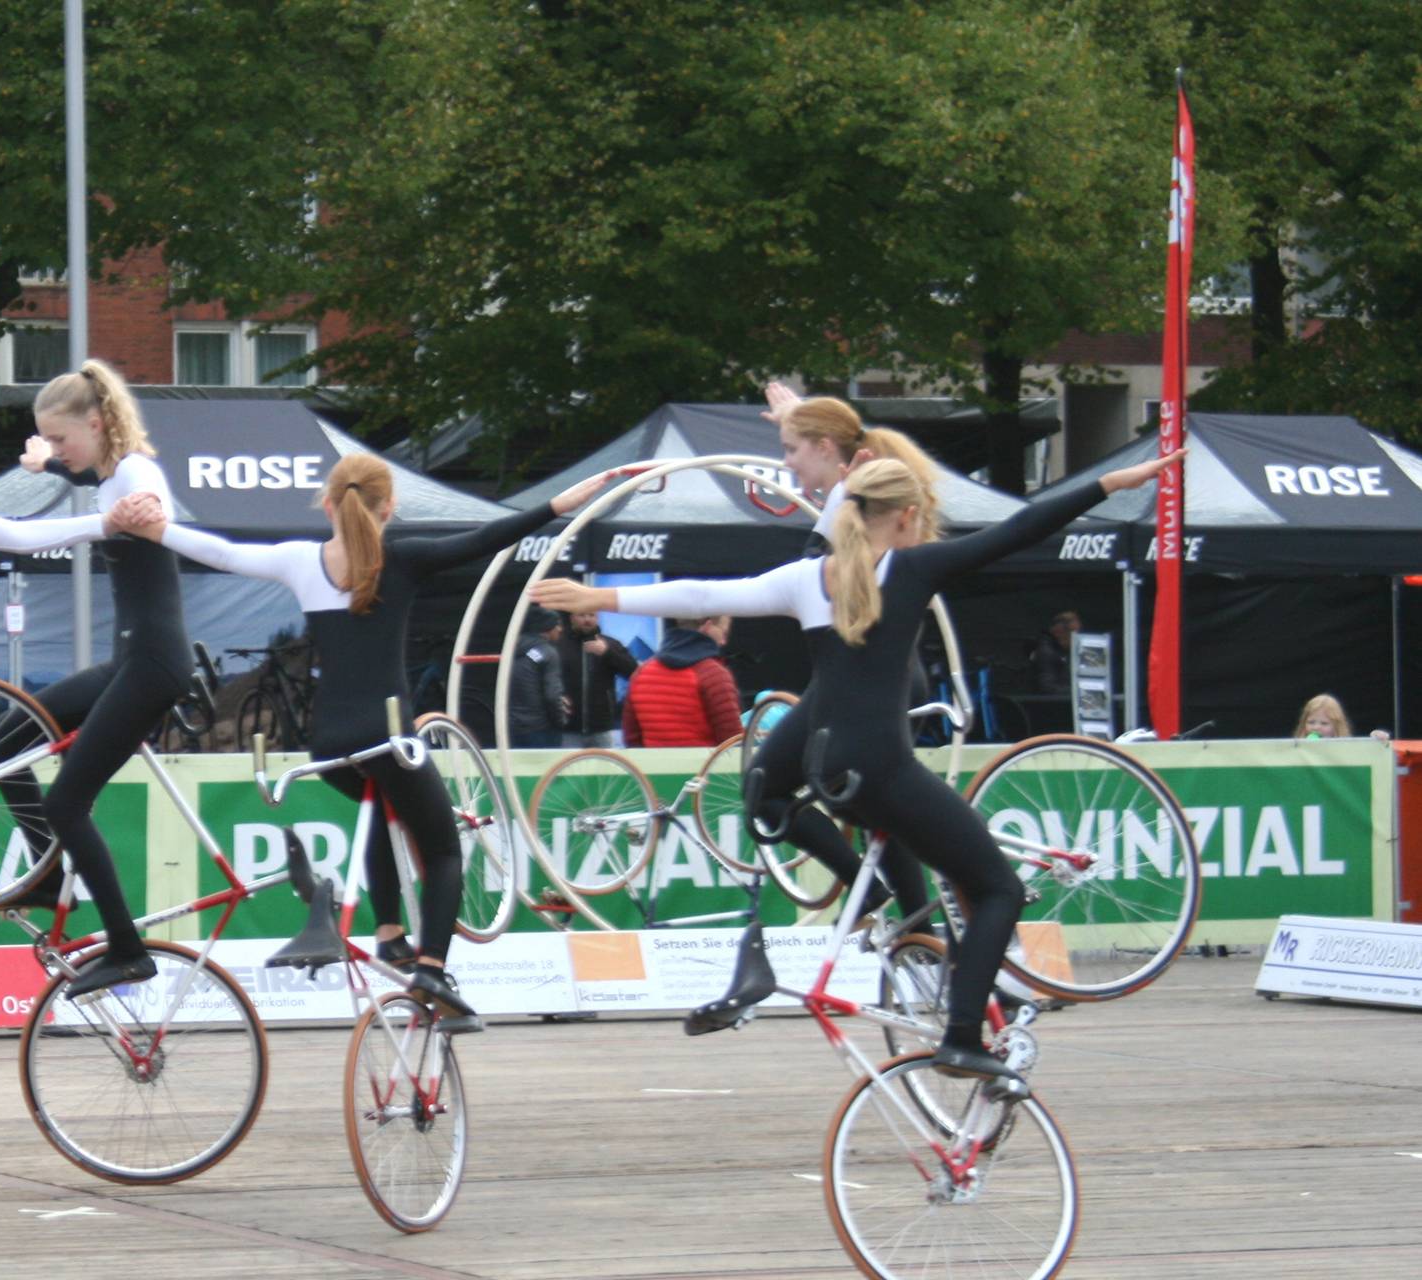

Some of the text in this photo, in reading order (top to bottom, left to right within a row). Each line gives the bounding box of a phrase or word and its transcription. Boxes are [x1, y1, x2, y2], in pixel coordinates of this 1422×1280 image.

[188, 455, 323, 489] ROSE
[1263, 464, 1391, 496] ROSE
[606, 533, 668, 560] ROSE
[1058, 533, 1118, 560] ROSE
[702, 937, 721, 949] Sie
[807, 935, 827, 946] auf
